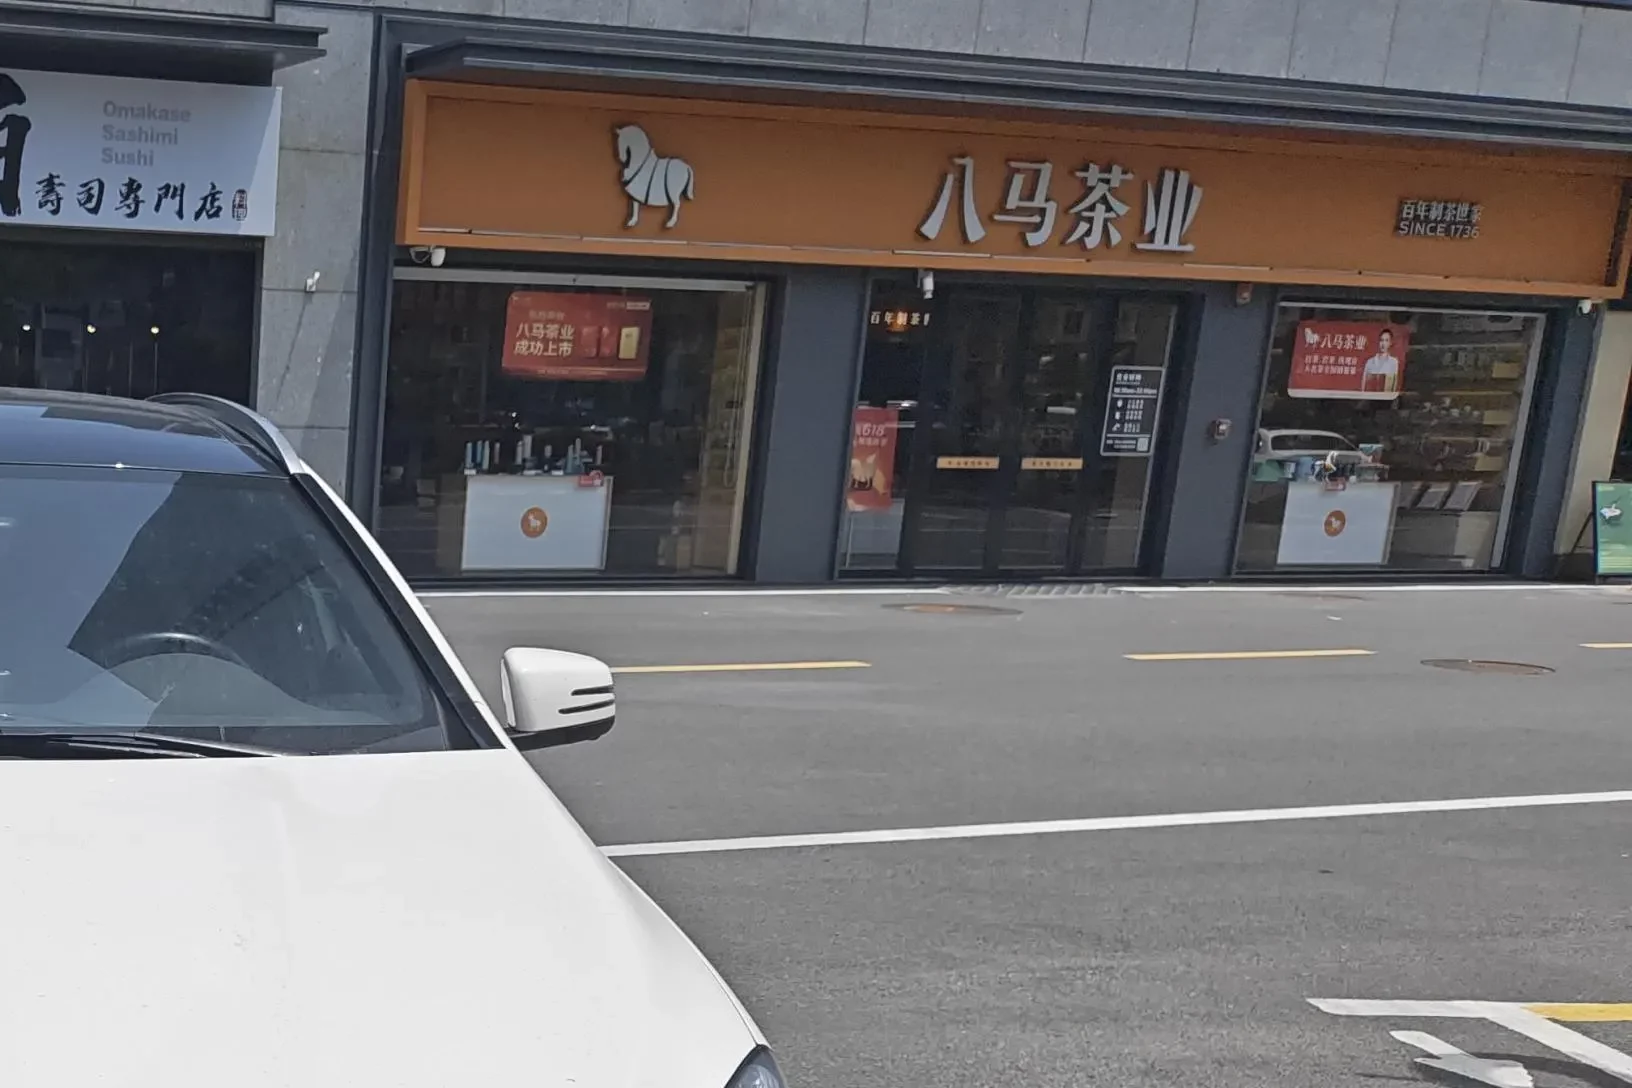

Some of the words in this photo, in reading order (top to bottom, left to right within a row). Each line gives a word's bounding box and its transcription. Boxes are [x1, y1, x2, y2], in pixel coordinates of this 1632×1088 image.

[103, 100, 191, 123] Omakase
[102, 124, 179, 146] Sashimi
[101, 147, 154, 167] Sushi
[920, 156, 1204, 251] 八马茶业
[1402, 199, 1481, 222] 百年制茶世家
[1399, 220, 1445, 236] SINCE
[1450, 224, 1480, 239] 1736
[515, 322, 575, 340] 八马茶业
[514, 340, 573, 357] 成功上市
[1320, 333, 1368, 350] 八马茶业
